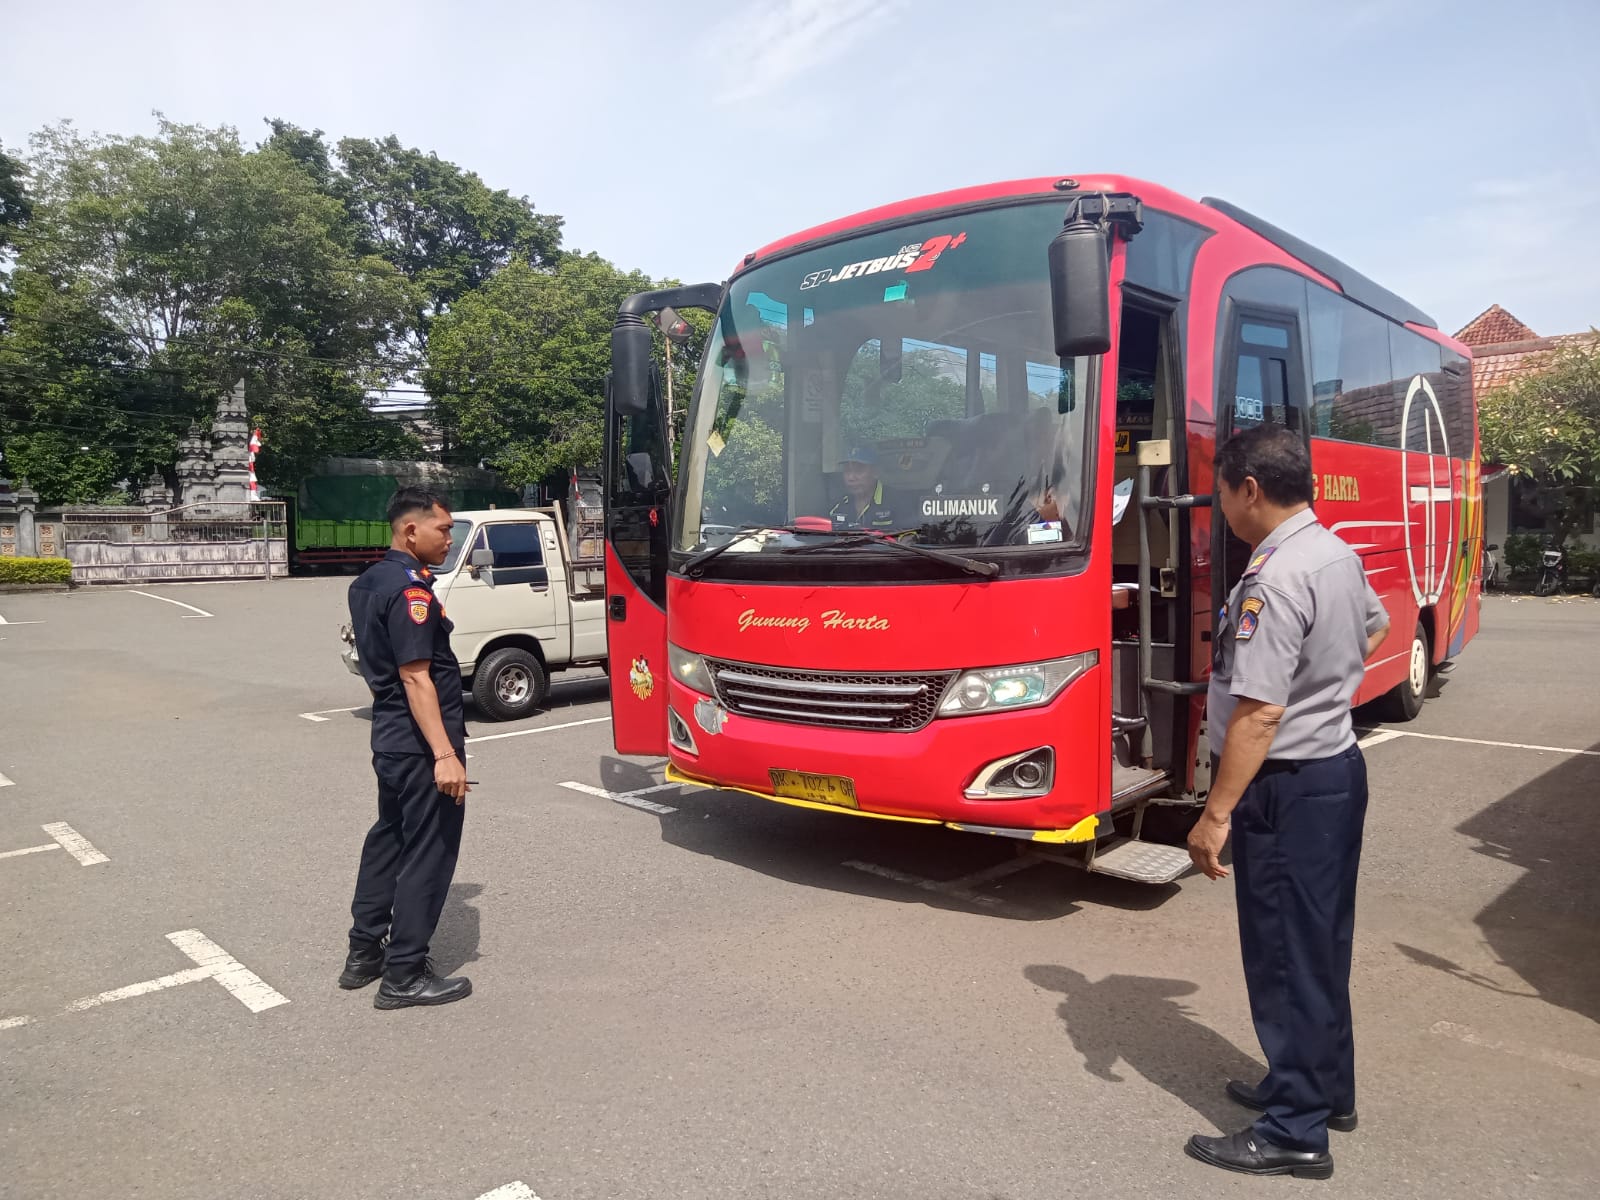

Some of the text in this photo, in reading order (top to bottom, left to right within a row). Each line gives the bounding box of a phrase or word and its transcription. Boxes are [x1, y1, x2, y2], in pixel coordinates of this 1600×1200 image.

[1323, 474, 1360, 502] HARTA
[922, 498, 998, 516] GILIMANUK
[737, 608, 891, 633] Gunung Harta
